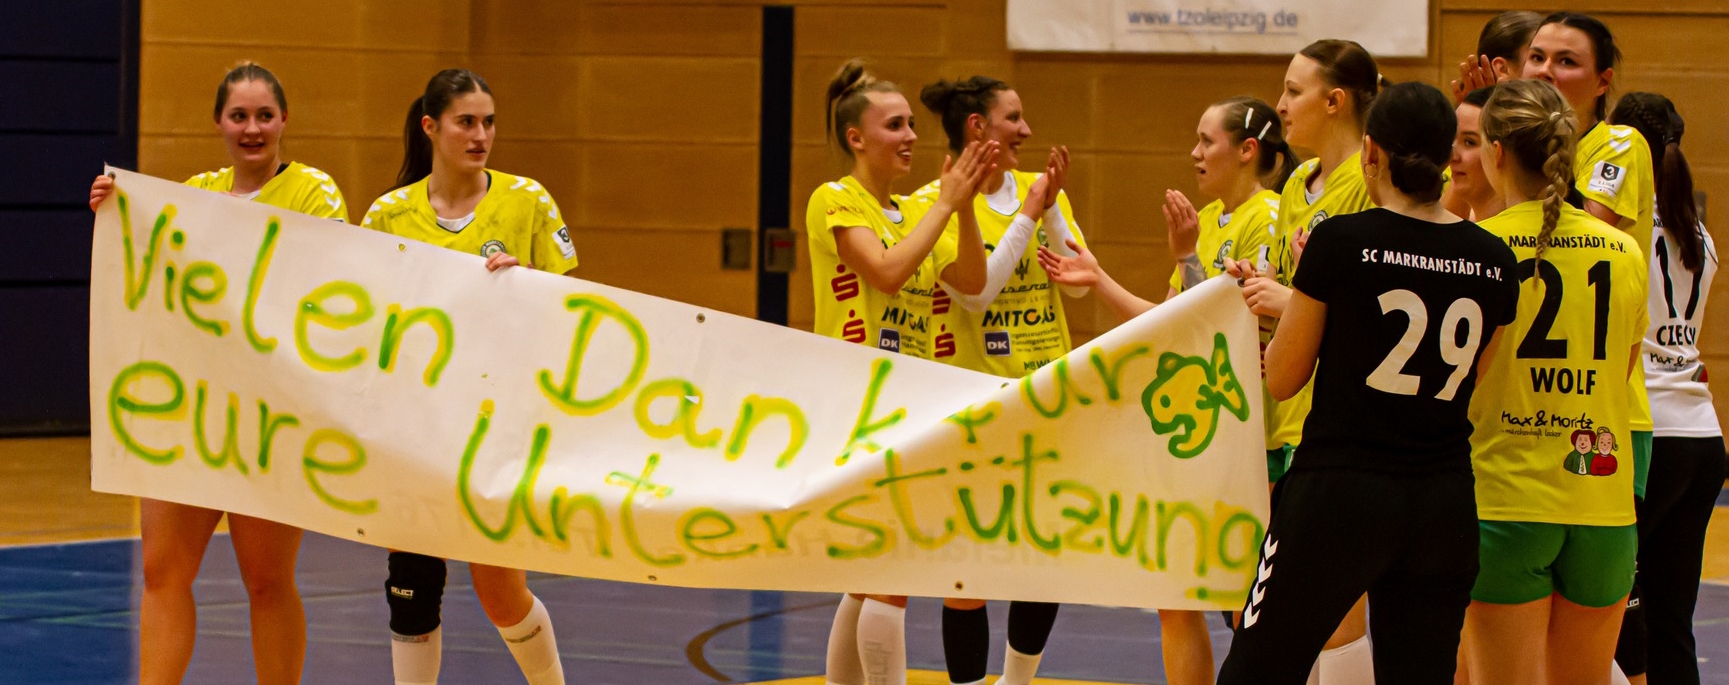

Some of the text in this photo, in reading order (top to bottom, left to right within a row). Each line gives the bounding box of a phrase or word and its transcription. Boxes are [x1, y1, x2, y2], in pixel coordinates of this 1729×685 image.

[1508, 234, 1627, 253] MARRANSTÄDT e.V.
[1362, 248, 1503, 281] SC MARKRANSTÄDT e.V.
[1516, 258, 1611, 361] 21
[114, 186, 454, 387] Vielen
[536, 294, 907, 470] Dank
[880, 338, 899, 349] DK
[986, 340, 1008, 350] DK
[1366, 288, 1484, 401] 29
[1530, 367, 1597, 395] WOLF
[1501, 410, 1594, 430] Max & Moritz
[107, 360, 1264, 606] eure Unterstützung
[391, 586, 414, 597] SELECT
